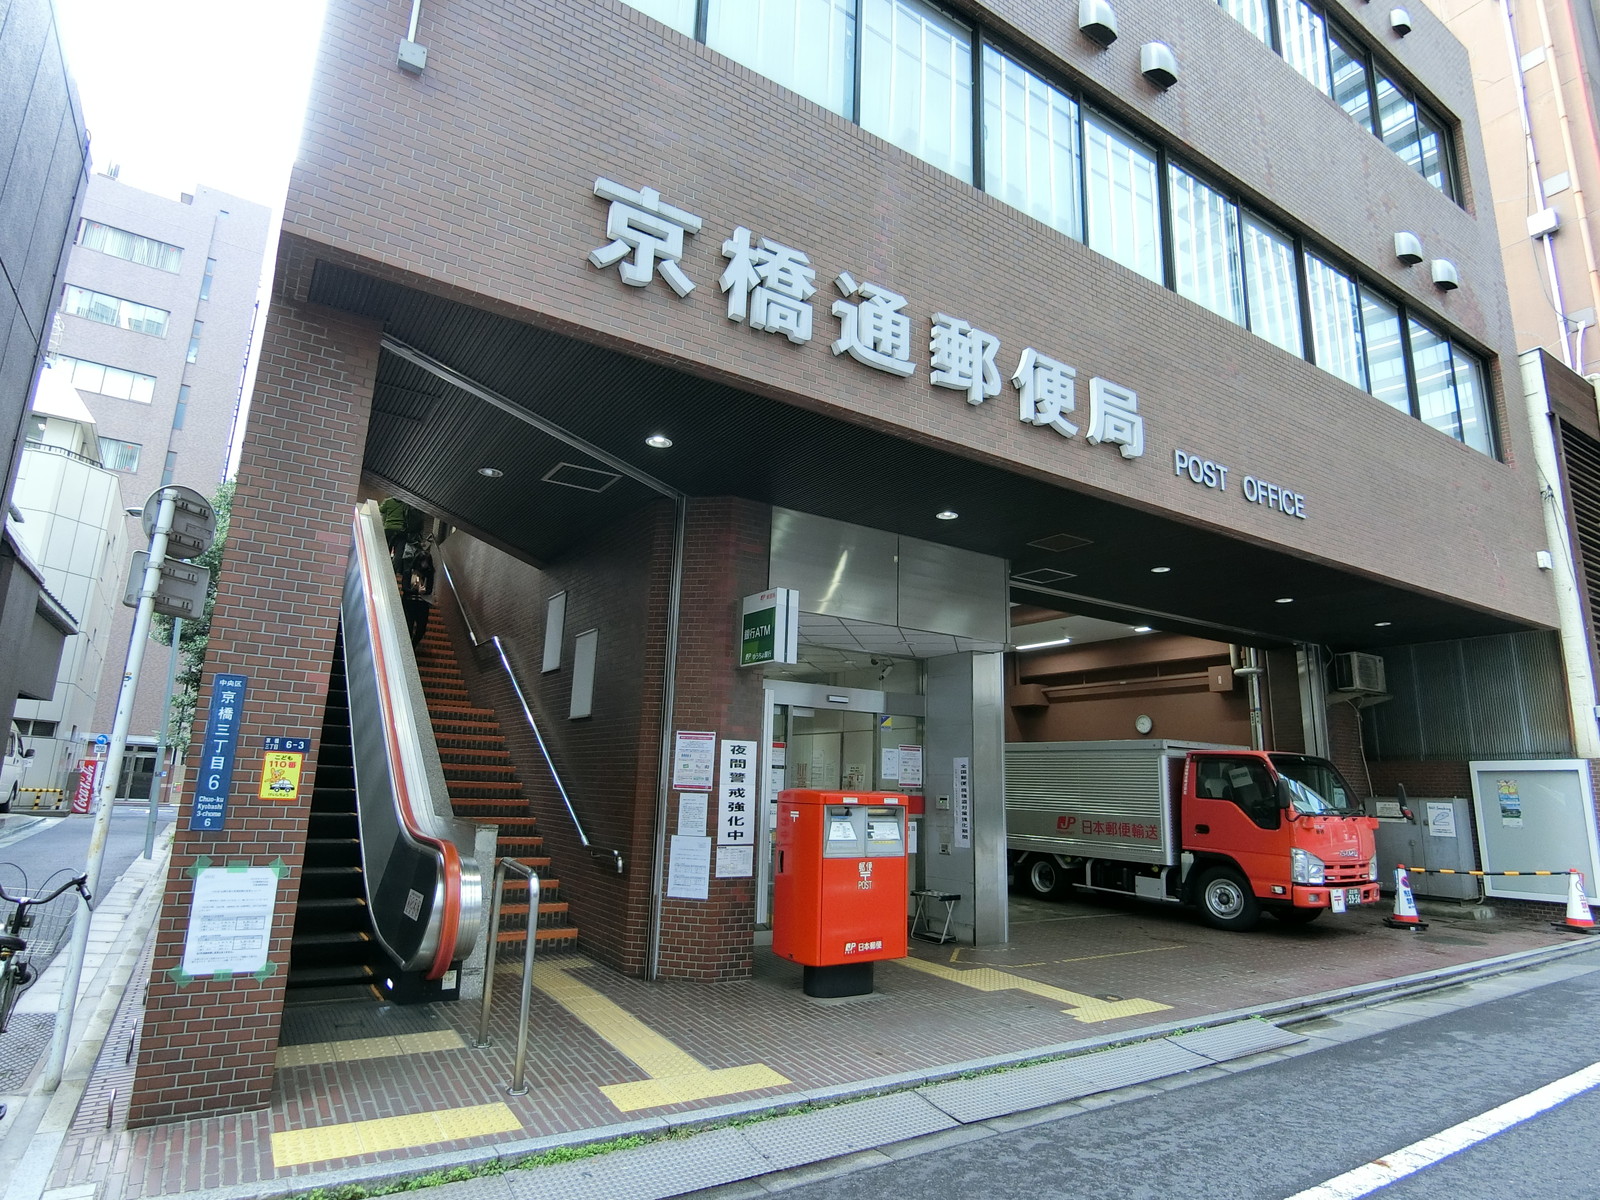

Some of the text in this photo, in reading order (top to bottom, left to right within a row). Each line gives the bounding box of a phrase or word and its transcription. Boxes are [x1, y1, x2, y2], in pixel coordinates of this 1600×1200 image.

[588, 177, 1145, 459] 京橋通郵便局
[1174, 449, 1307, 520] POST OFFICE
[219, 680, 243, 688] 中央区
[286, 740, 305, 750] 6-3
[727, 744, 747, 841] 夜間警戒強化中
[197, 803, 223, 811] Kyobashi
[204, 818, 211, 827] 6
[1081, 820, 1158, 840] 日本郵便輸送
[858, 861, 873, 873] 郵便
[858, 880, 873, 890] POST
[858, 940, 882, 952] 日本郵便
